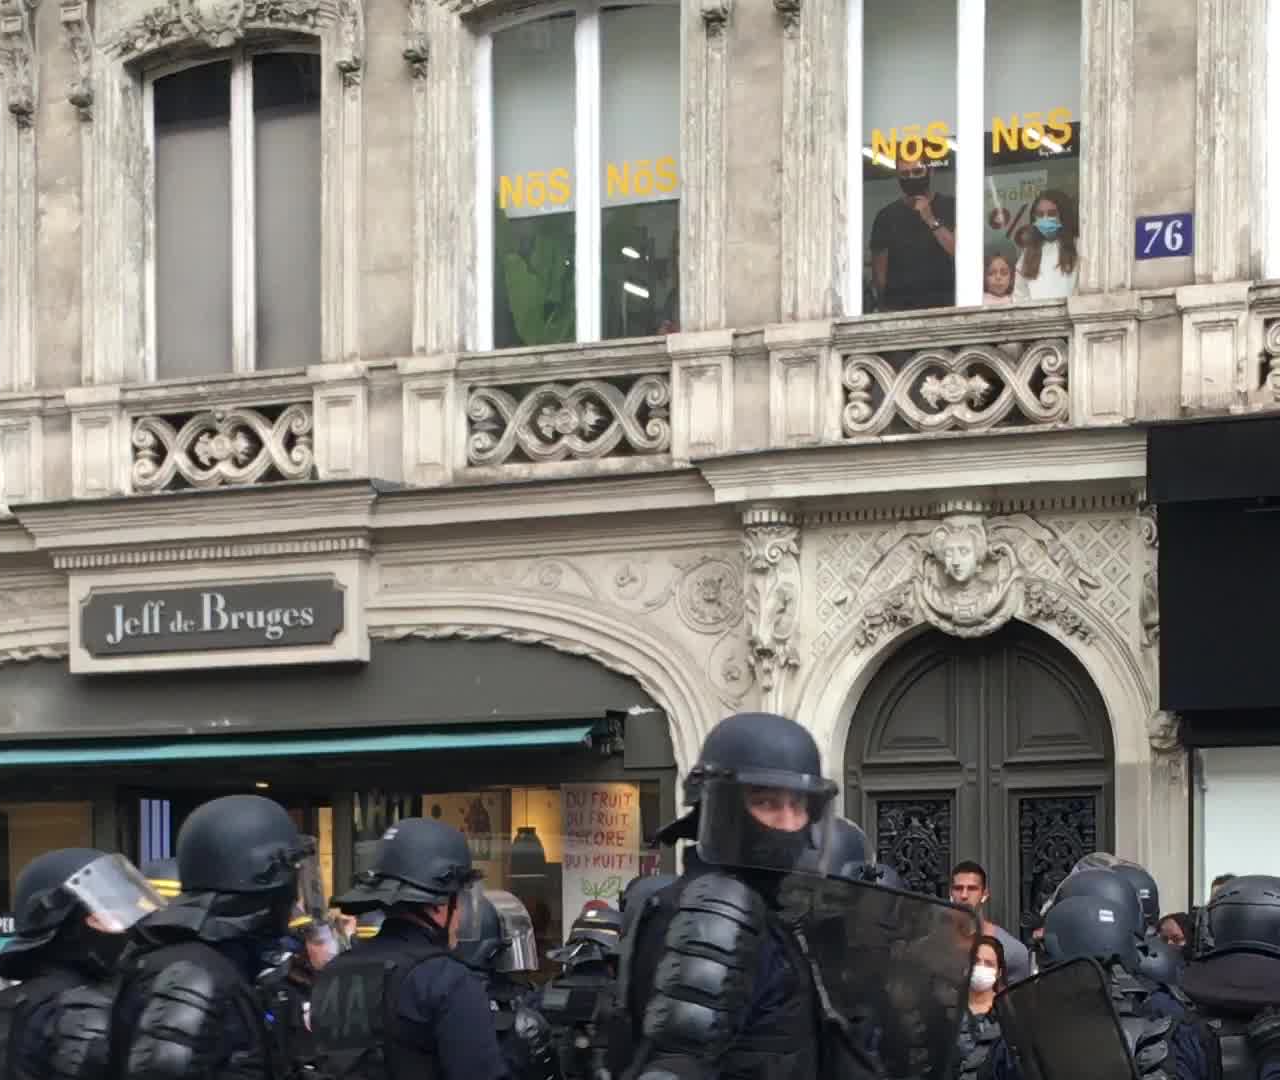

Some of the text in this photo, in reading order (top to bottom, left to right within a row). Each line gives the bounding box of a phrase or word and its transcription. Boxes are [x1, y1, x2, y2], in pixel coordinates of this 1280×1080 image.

[1143, 220, 1183, 254] 76
[106, 592, 314, 644] Jeff de Bruges
[591, 791, 632, 808] FRUIT
[590, 812, 629, 827] FRUIT
